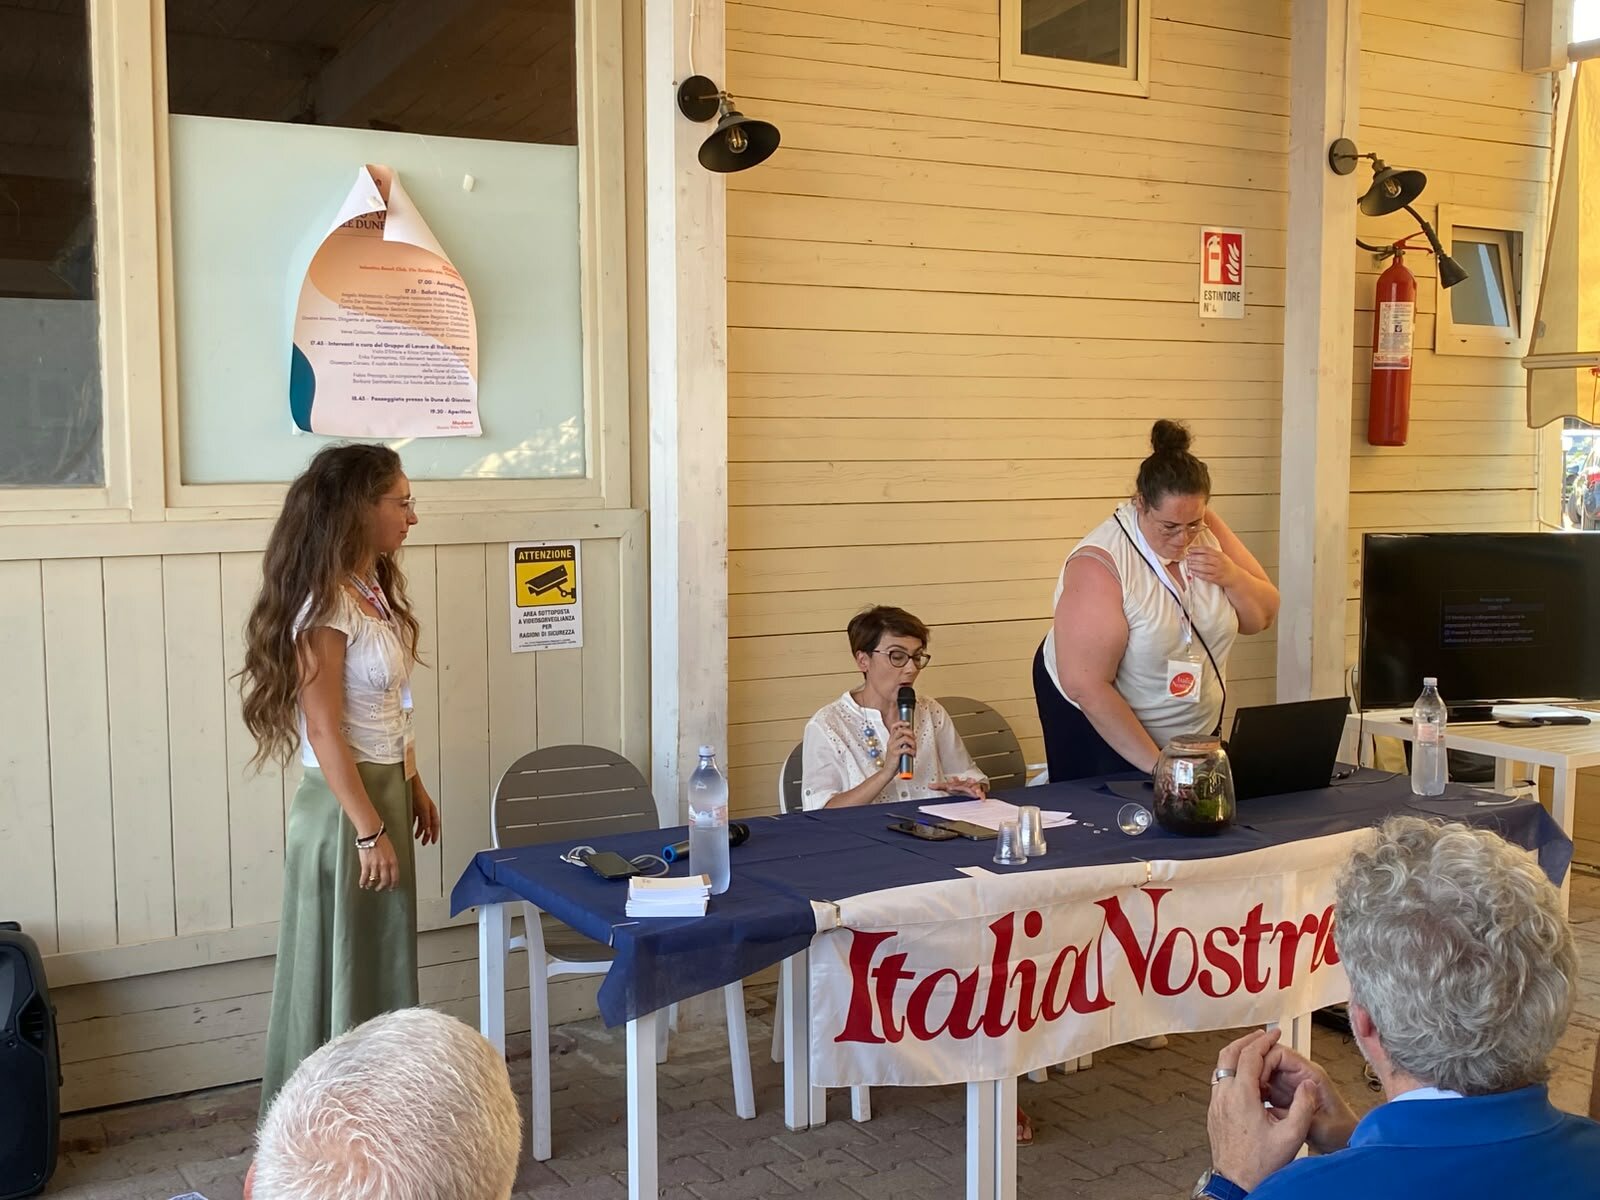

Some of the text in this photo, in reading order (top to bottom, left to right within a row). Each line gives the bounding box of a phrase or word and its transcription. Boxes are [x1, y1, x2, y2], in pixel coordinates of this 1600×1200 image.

[1204, 290, 1240, 302] ESTINTORE
[518, 549, 572, 560] ATTENZIONE
[523, 616, 575, 624] VIDEOSORVEGLIANZA
